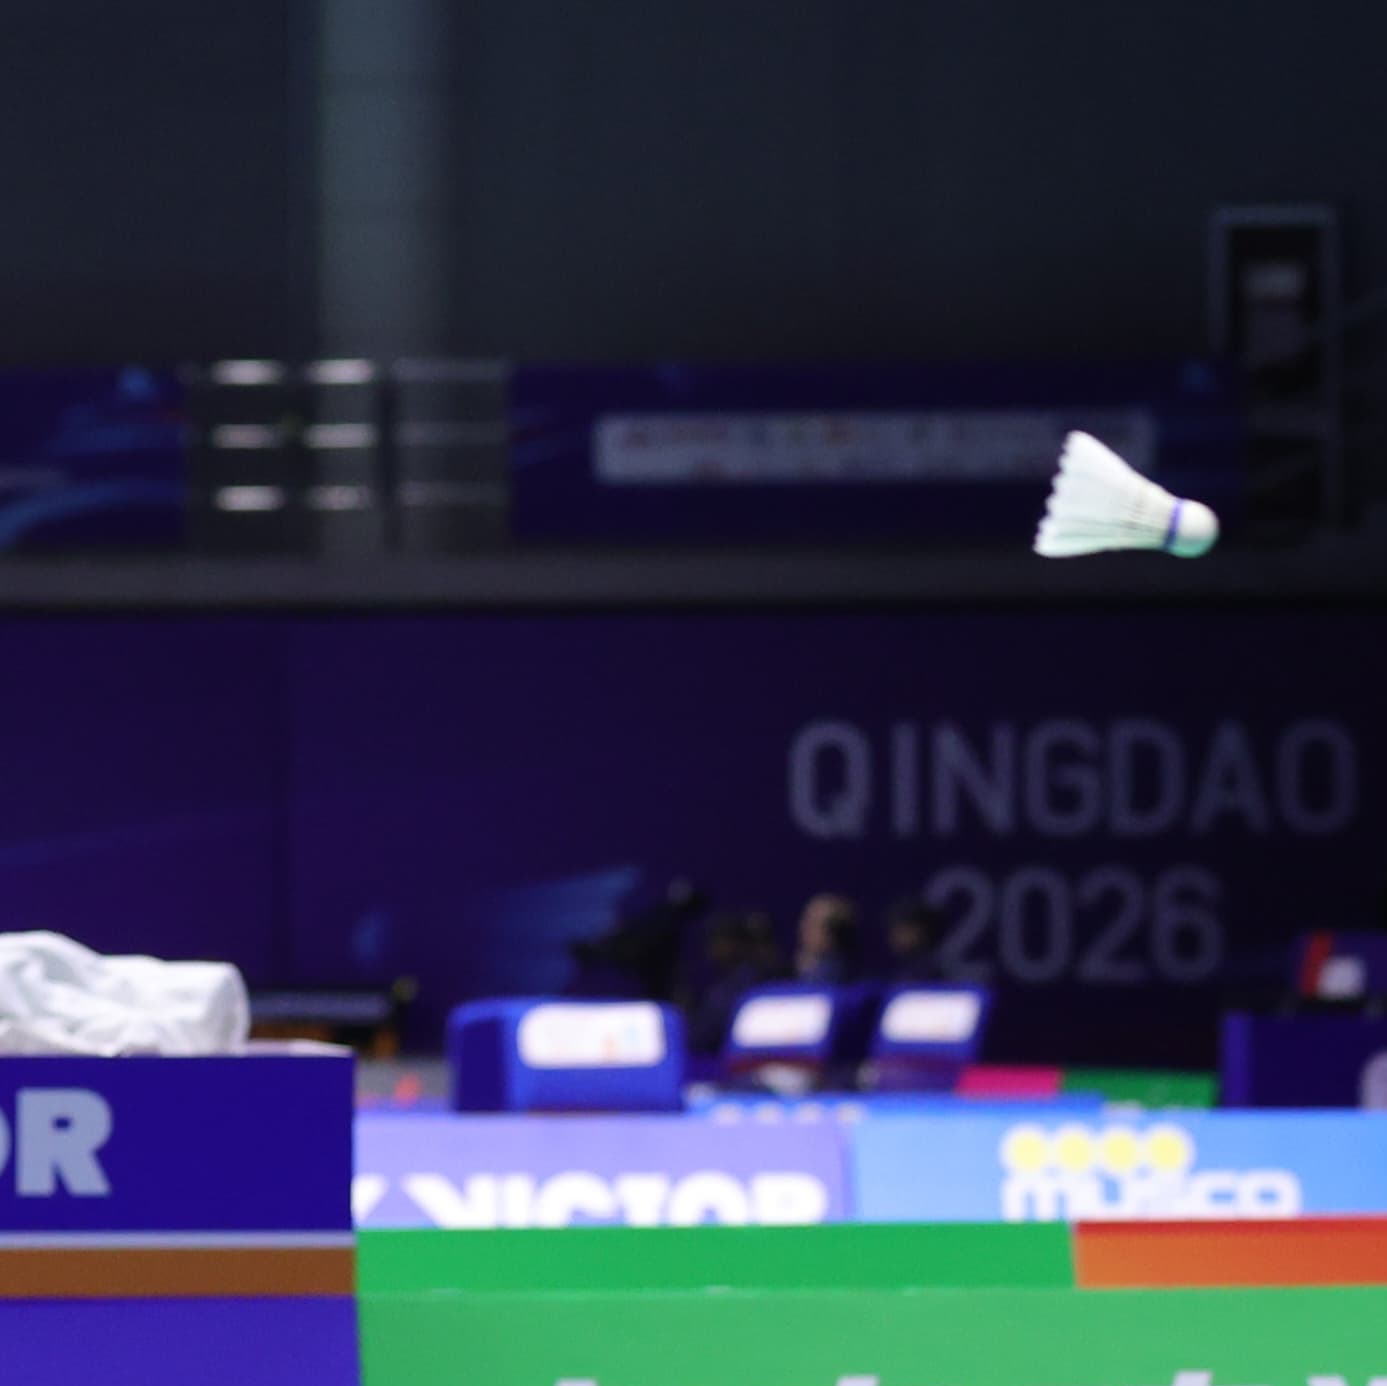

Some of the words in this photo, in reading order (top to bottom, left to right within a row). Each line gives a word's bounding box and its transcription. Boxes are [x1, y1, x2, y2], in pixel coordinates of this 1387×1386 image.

[787, 715, 1362, 840] QINGDAO
[923, 862, 1227, 986] 2026
[0, 1086, 113, 1197] R
